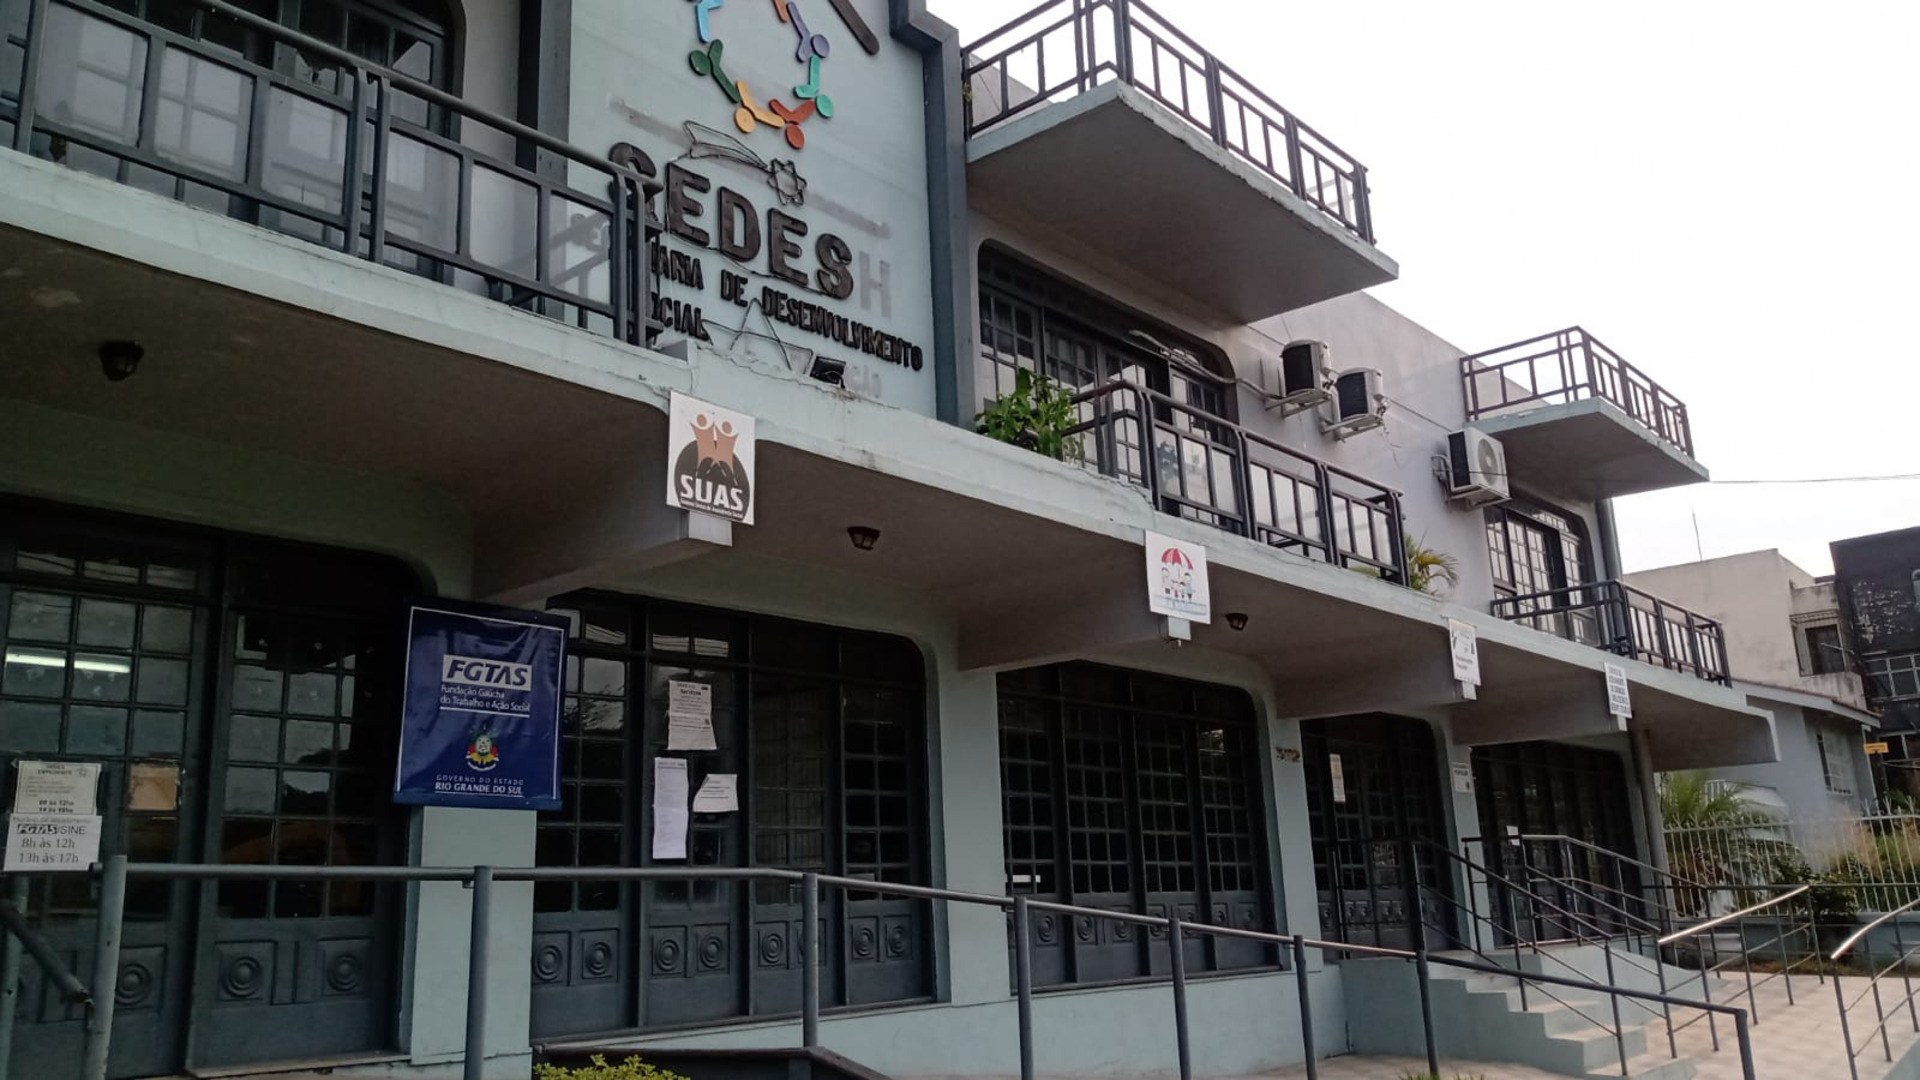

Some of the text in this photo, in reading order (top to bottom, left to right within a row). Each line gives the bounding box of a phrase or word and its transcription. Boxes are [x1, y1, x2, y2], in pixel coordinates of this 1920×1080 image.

[720, 269, 750, 308] DE
[762, 285, 923, 372] DESENVOLVIMENTO
[680, 474, 743, 512] SUAS
[446, 659, 528, 687] FGTAS
[440, 684, 505, 699] Fundação Gaúcha
[440, 695, 451, 704] do
[452, 696, 484, 708] Trabalho
[491, 701, 509, 711] Ação
[435, 781, 523, 794] RIO GRANDE DO SUL
[436, 774, 476, 783] GOVERNO
[493, 778, 524, 786] ESTADO
[21, 837, 75, 848] 8h às 12h
[19, 853, 78, 864] 13h às 17h
